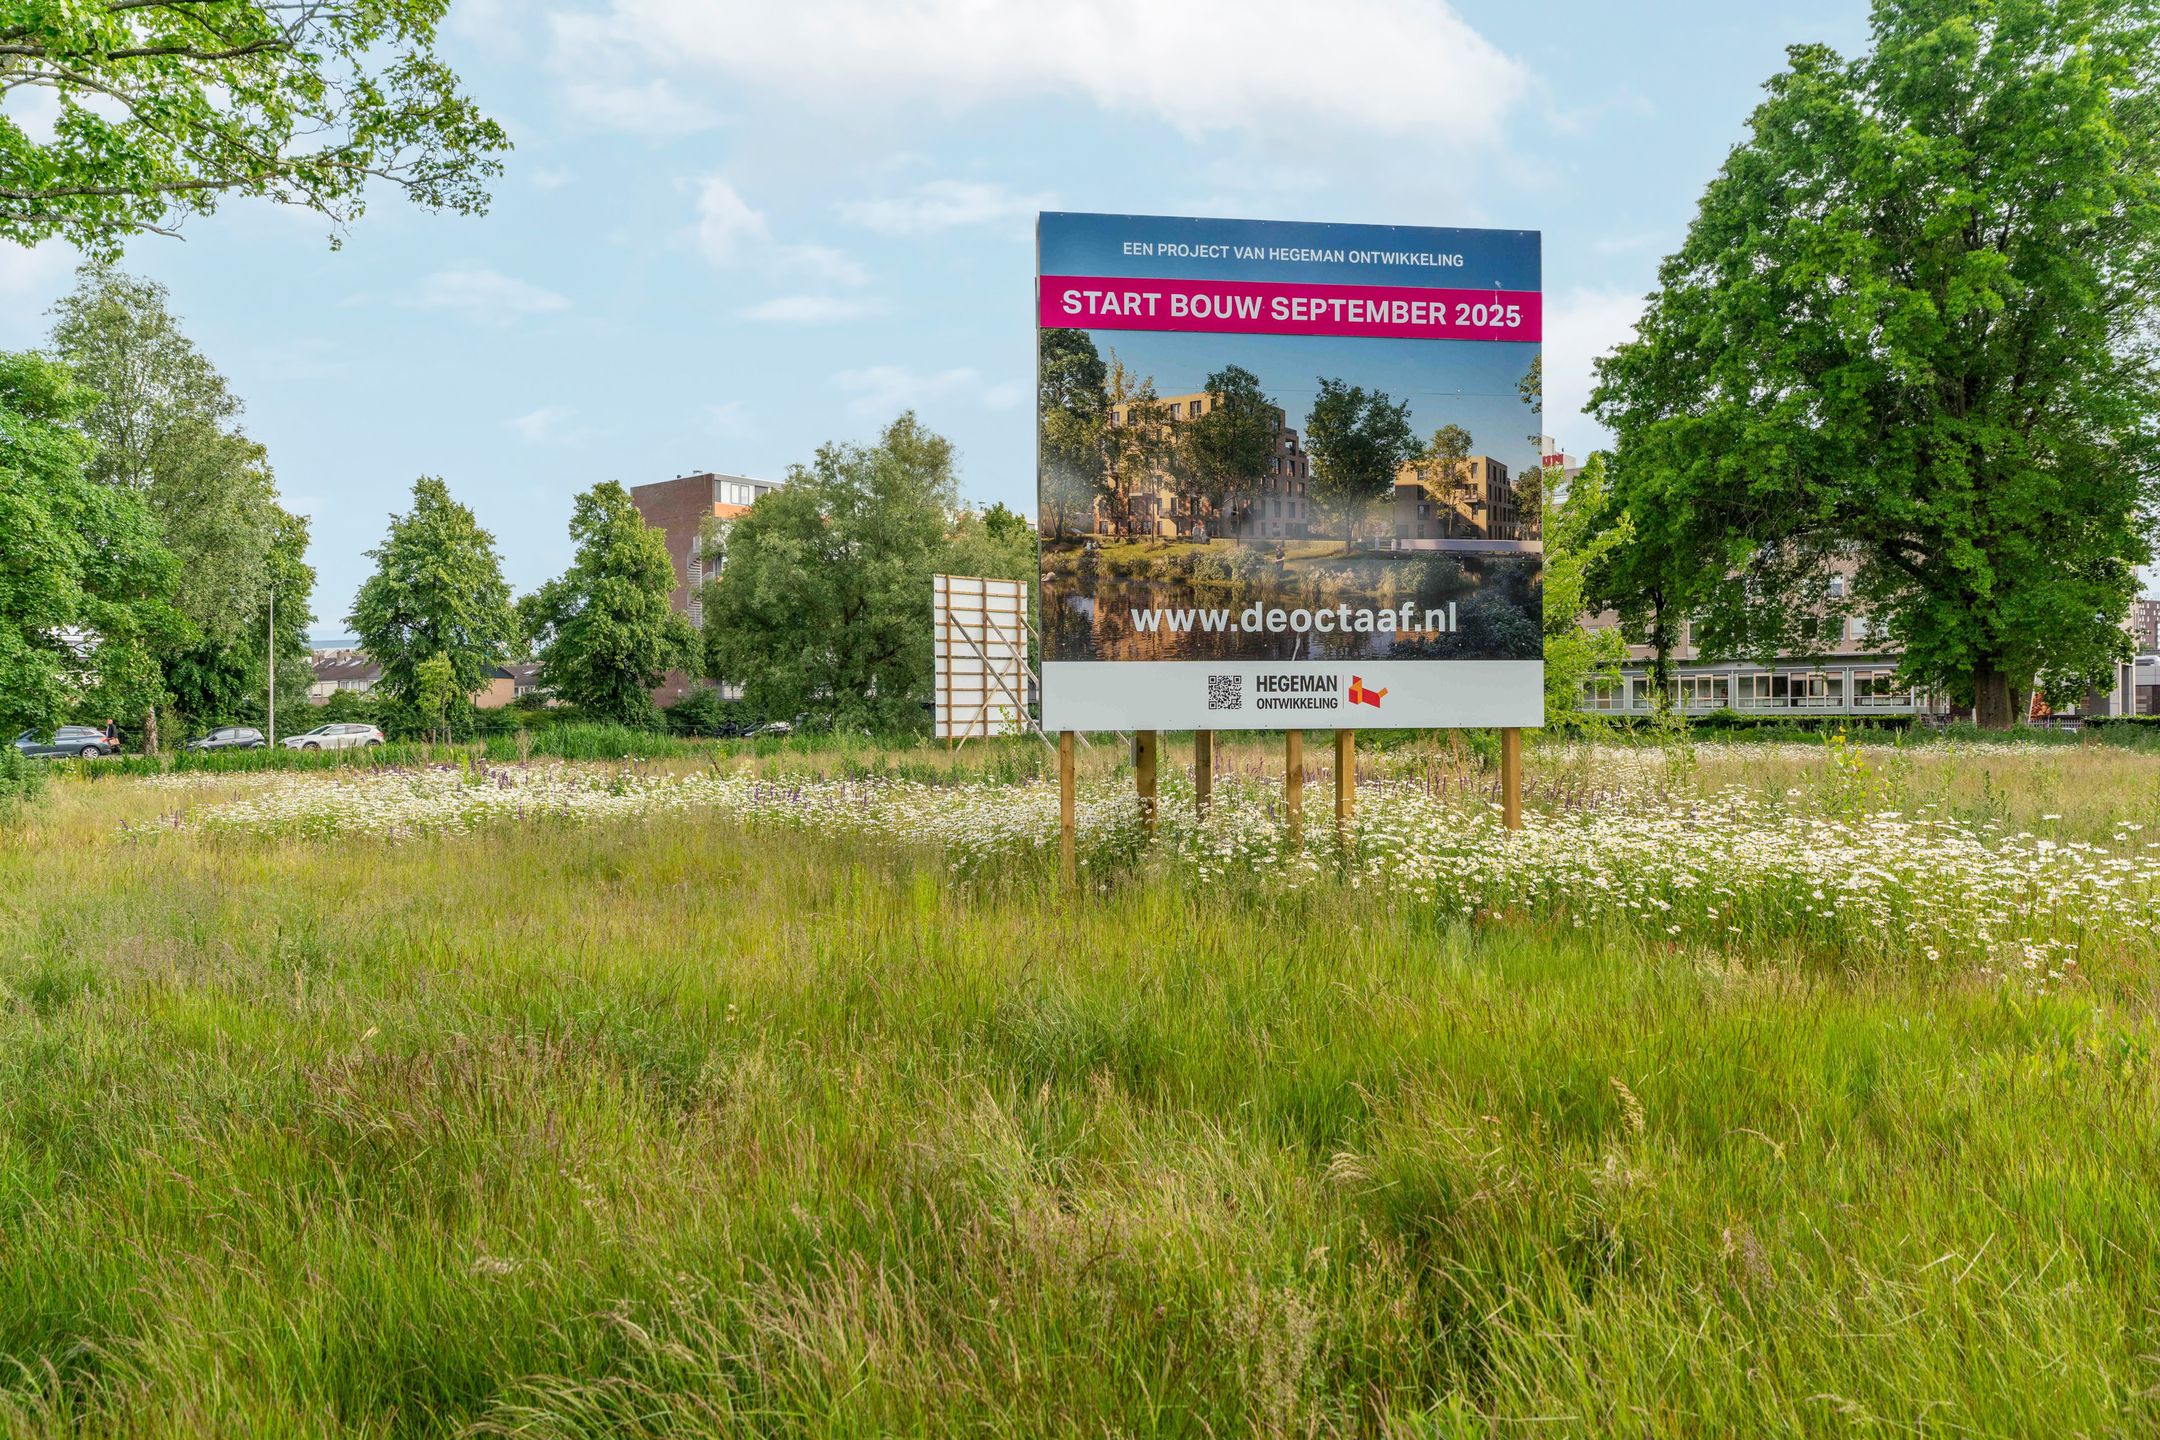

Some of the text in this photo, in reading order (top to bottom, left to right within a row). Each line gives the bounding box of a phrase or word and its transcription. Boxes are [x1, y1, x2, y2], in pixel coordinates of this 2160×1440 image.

[1123, 241, 1464, 267] EEN PROJECT VAN HEGEMAN ONTWIKKELING
[1062, 289, 1521, 328] START BOUW SEPTEMBER 2025
[1131, 601, 1457, 633] www.deoctaaf.nl
[1256, 674, 1338, 693] HEGEMAN
[1256, 697, 1338, 710] ONTWIKKELING
